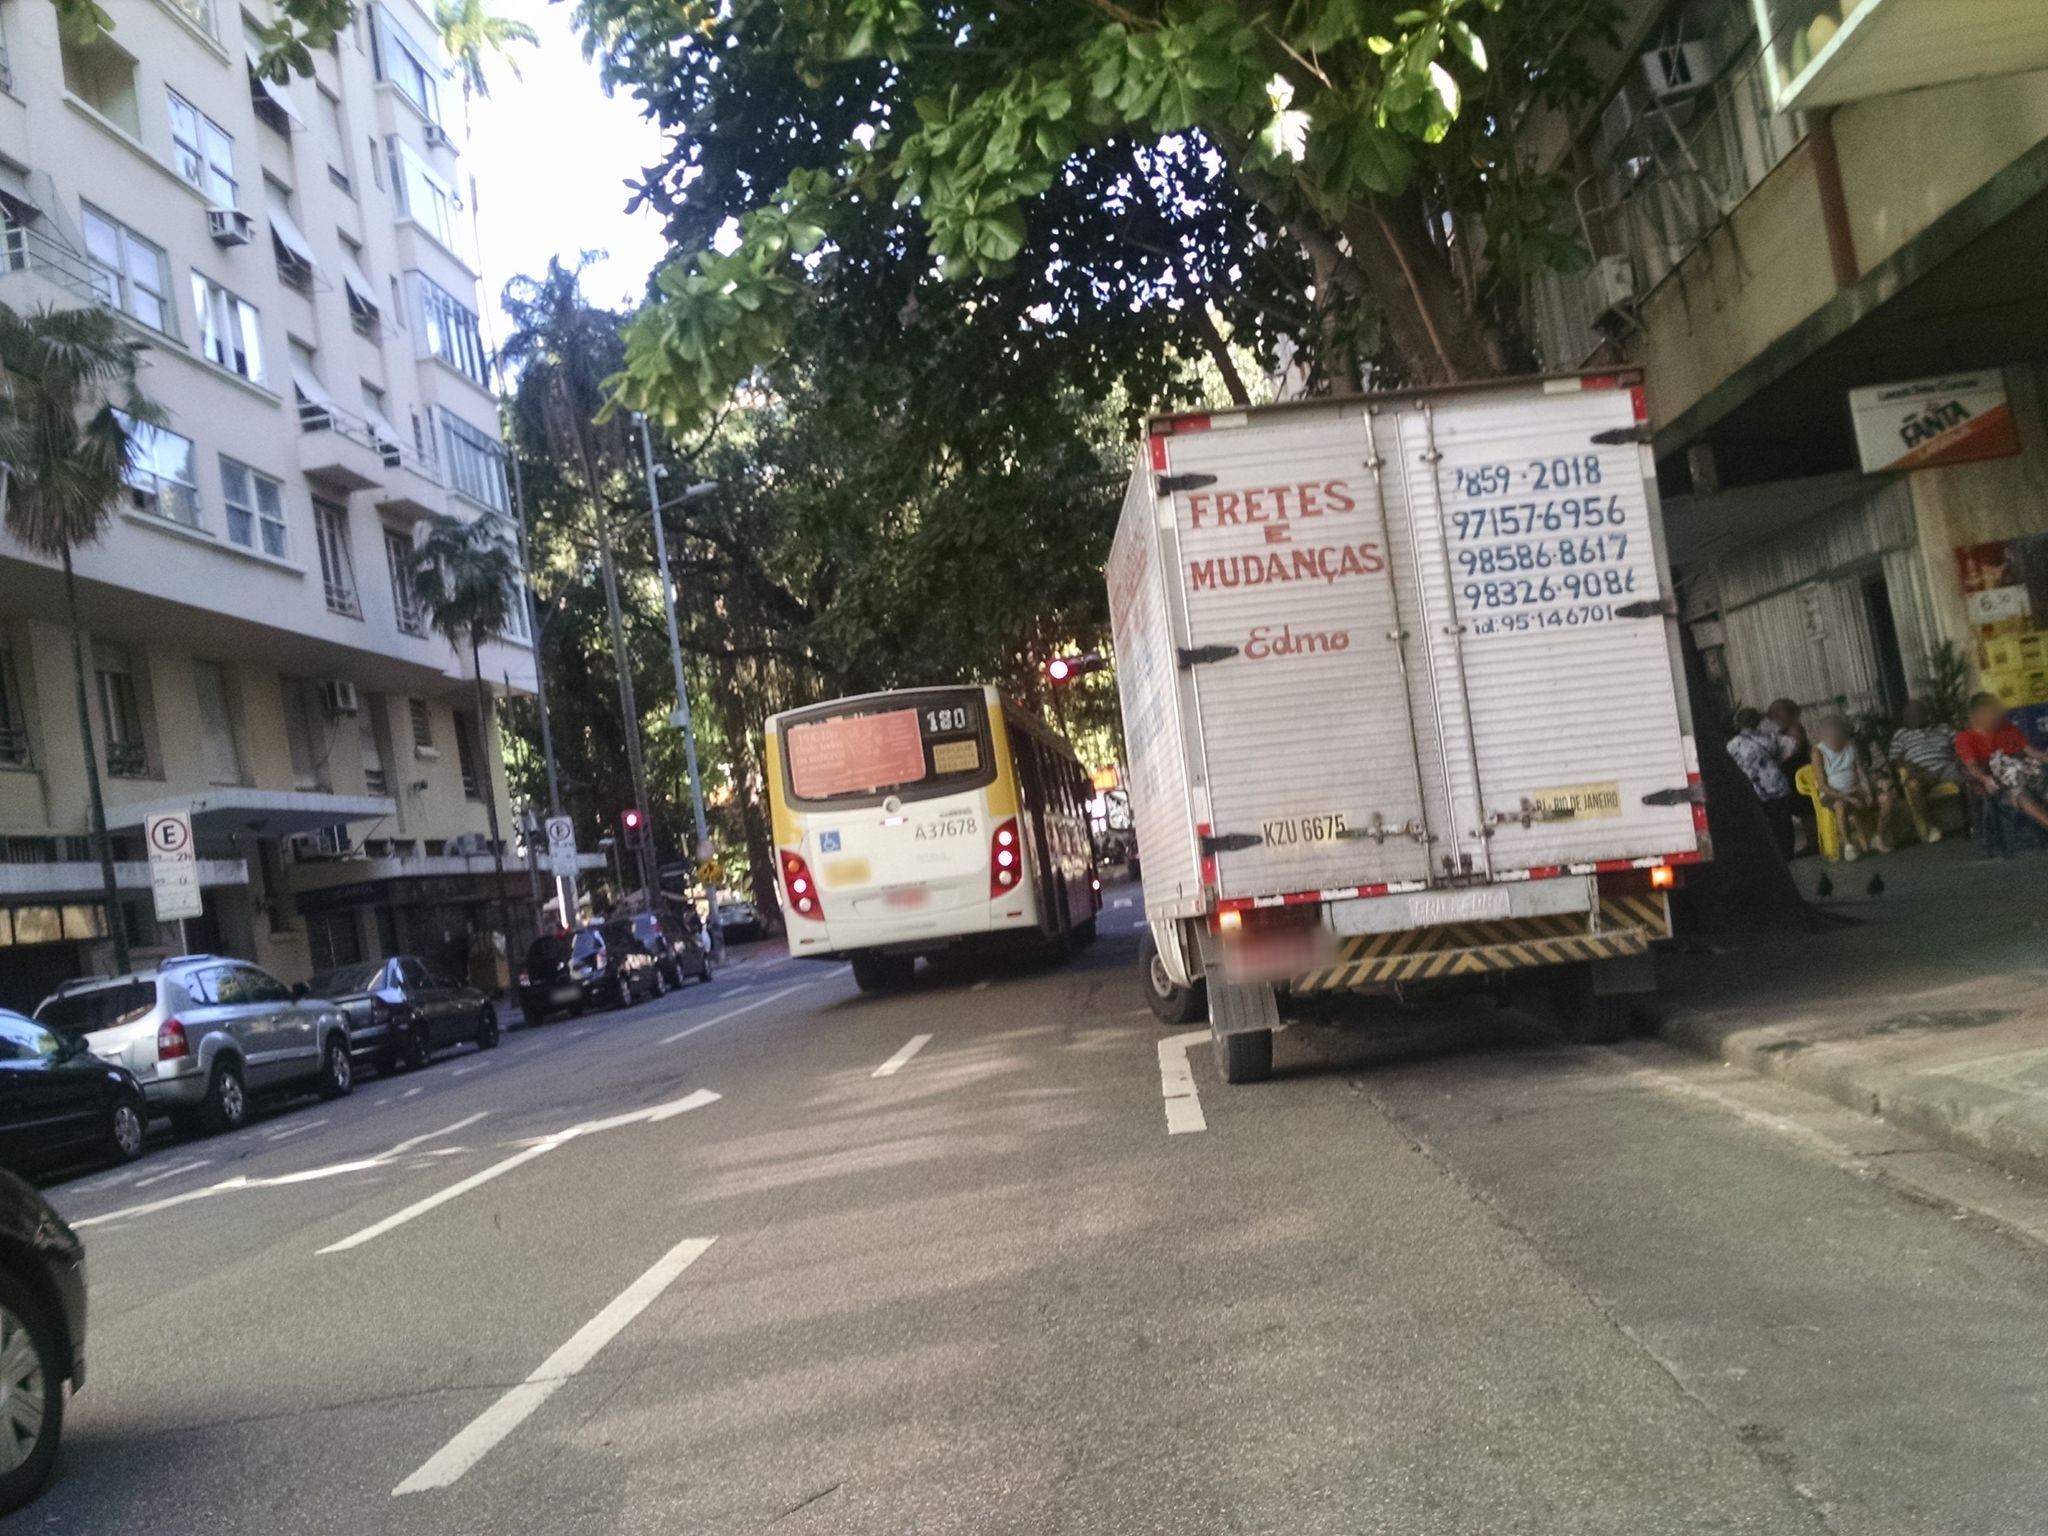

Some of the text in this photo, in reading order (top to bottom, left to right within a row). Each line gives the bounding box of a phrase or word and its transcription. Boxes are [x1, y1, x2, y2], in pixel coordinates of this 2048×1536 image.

[1900, 400, 1971, 449] FANTA
[1188, 480, 1356, 529] FRETES
[1264, 523, 1292, 545] E
[1189, 543, 1385, 591] MUDANÇAS
[1244, 624, 1350, 660] Edmo
[926, 707, 966, 732] 180
[1554, 795, 1569, 811] RIO
[1570, 794, 1582, 812] DE
[1583, 791, 1618, 811] JANEIRO
[162, 825, 177, 845] E
[915, 818, 977, 840] A37678
[1263, 813, 1346, 848] KZU 6675
